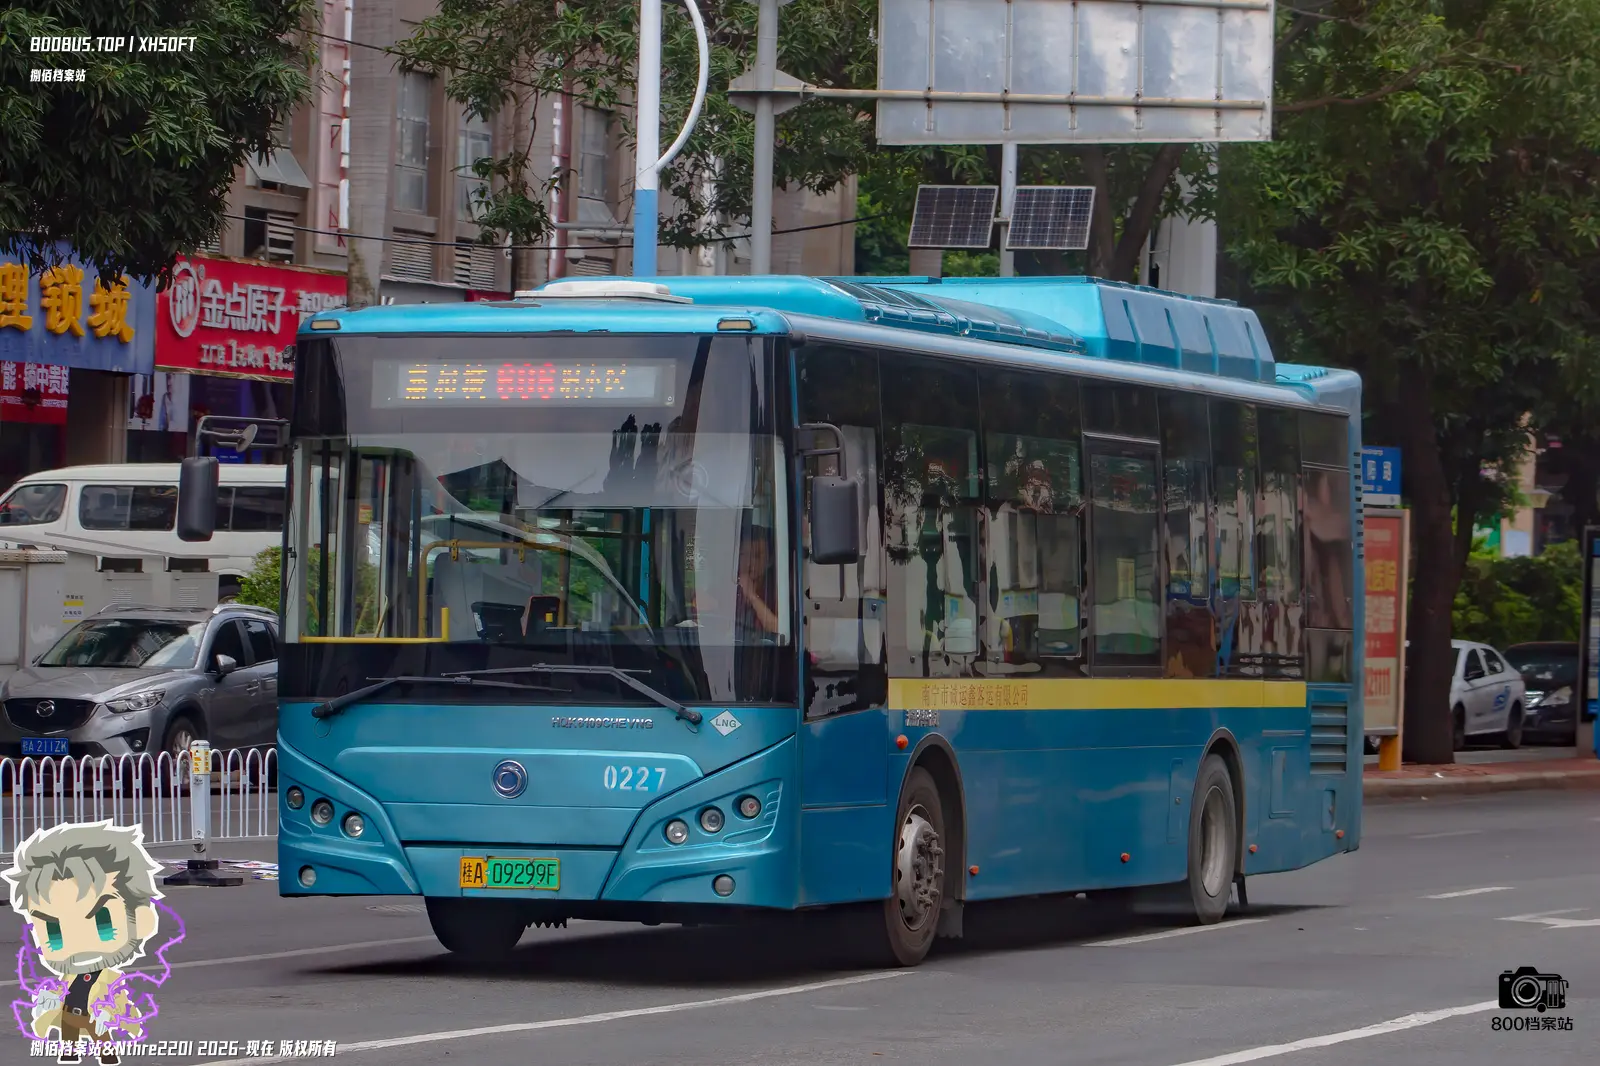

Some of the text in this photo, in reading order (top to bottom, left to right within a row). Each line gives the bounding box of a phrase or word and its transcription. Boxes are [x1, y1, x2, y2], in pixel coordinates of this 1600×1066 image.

[715, 718, 737, 728] LNG
[603, 765, 667, 792] 0227
[462, 862, 557, 885] 桂A 09299F
